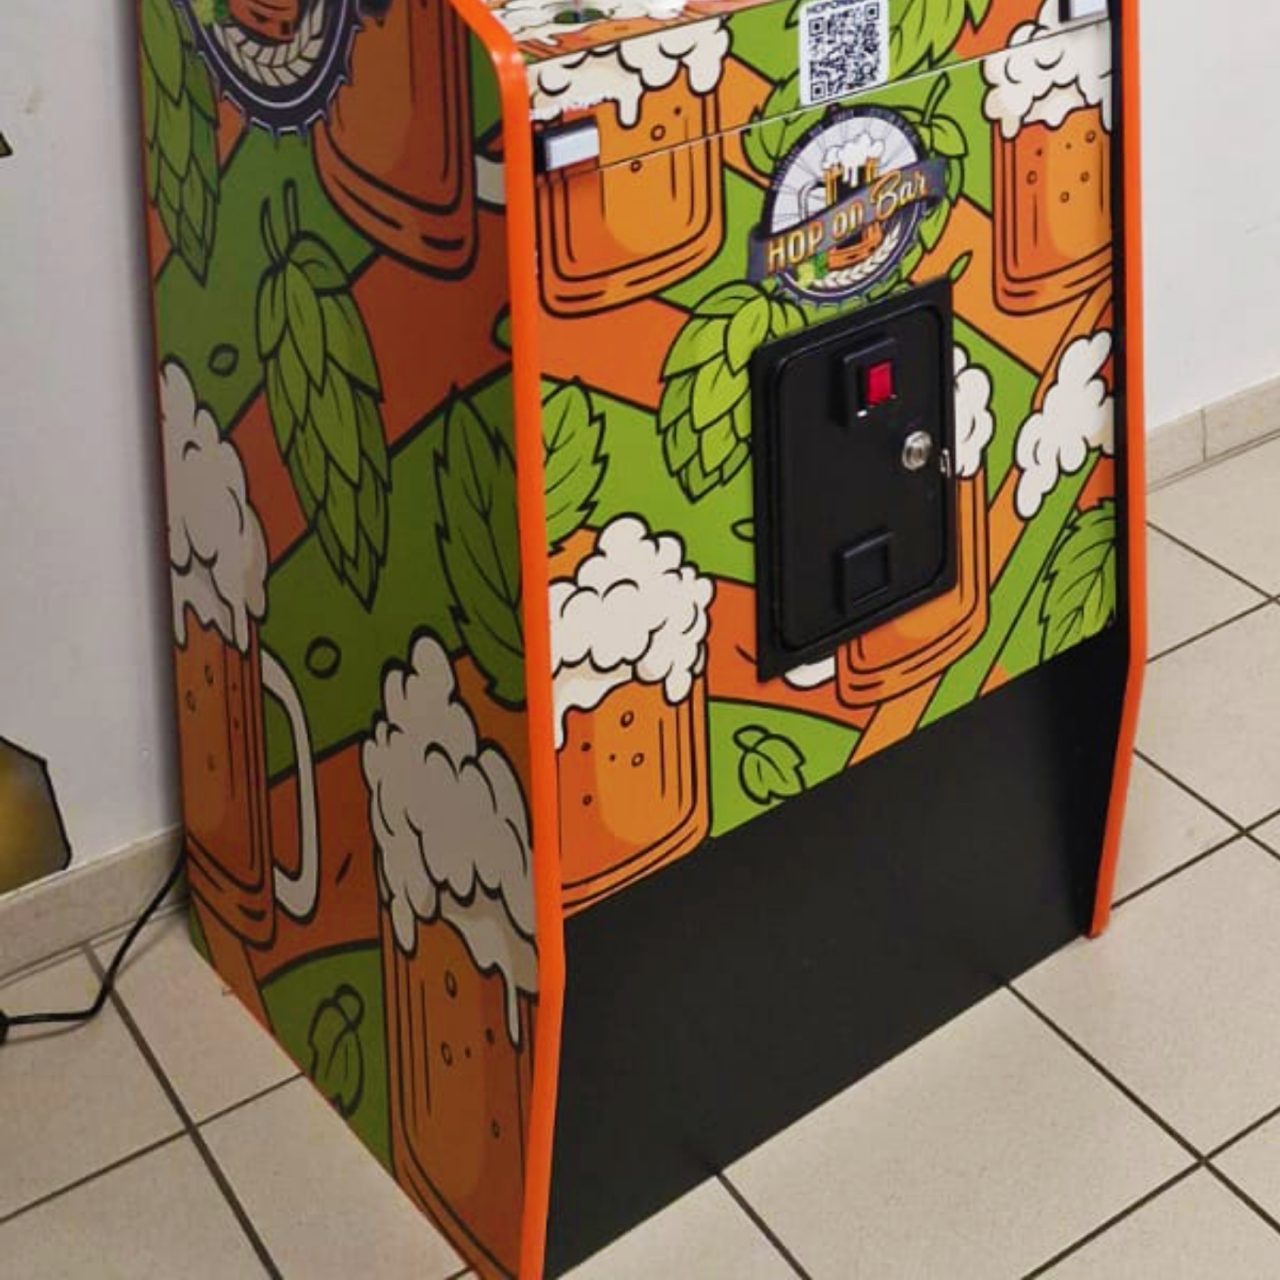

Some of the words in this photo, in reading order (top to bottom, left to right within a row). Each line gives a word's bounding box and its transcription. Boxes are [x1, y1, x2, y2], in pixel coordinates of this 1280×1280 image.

[766, 220, 825, 276] HOP
[832, 197, 865, 240] on
[870, 167, 928, 220] Bar
